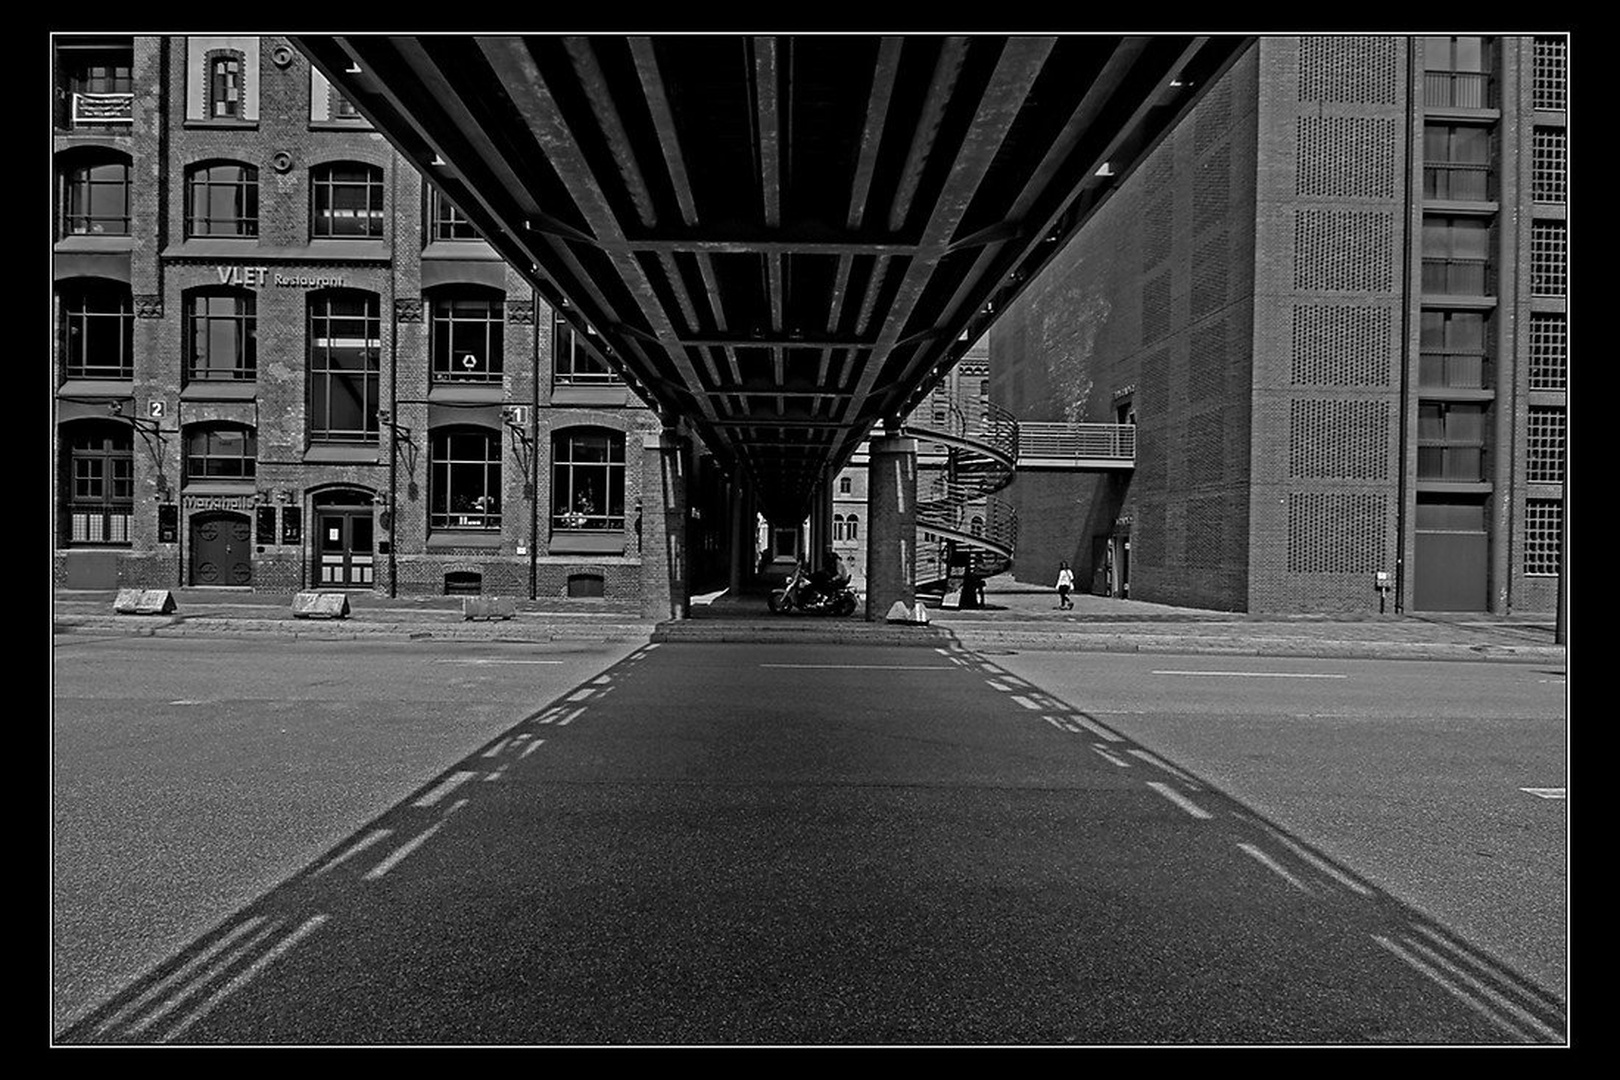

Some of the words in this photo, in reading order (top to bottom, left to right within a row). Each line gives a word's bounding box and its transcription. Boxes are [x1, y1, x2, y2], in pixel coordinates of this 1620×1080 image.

[217, 265, 268, 285] VLET
[274, 272, 344, 287] Restaurant
[152, 402, 162, 417] 2
[513, 407, 522, 422] 1
